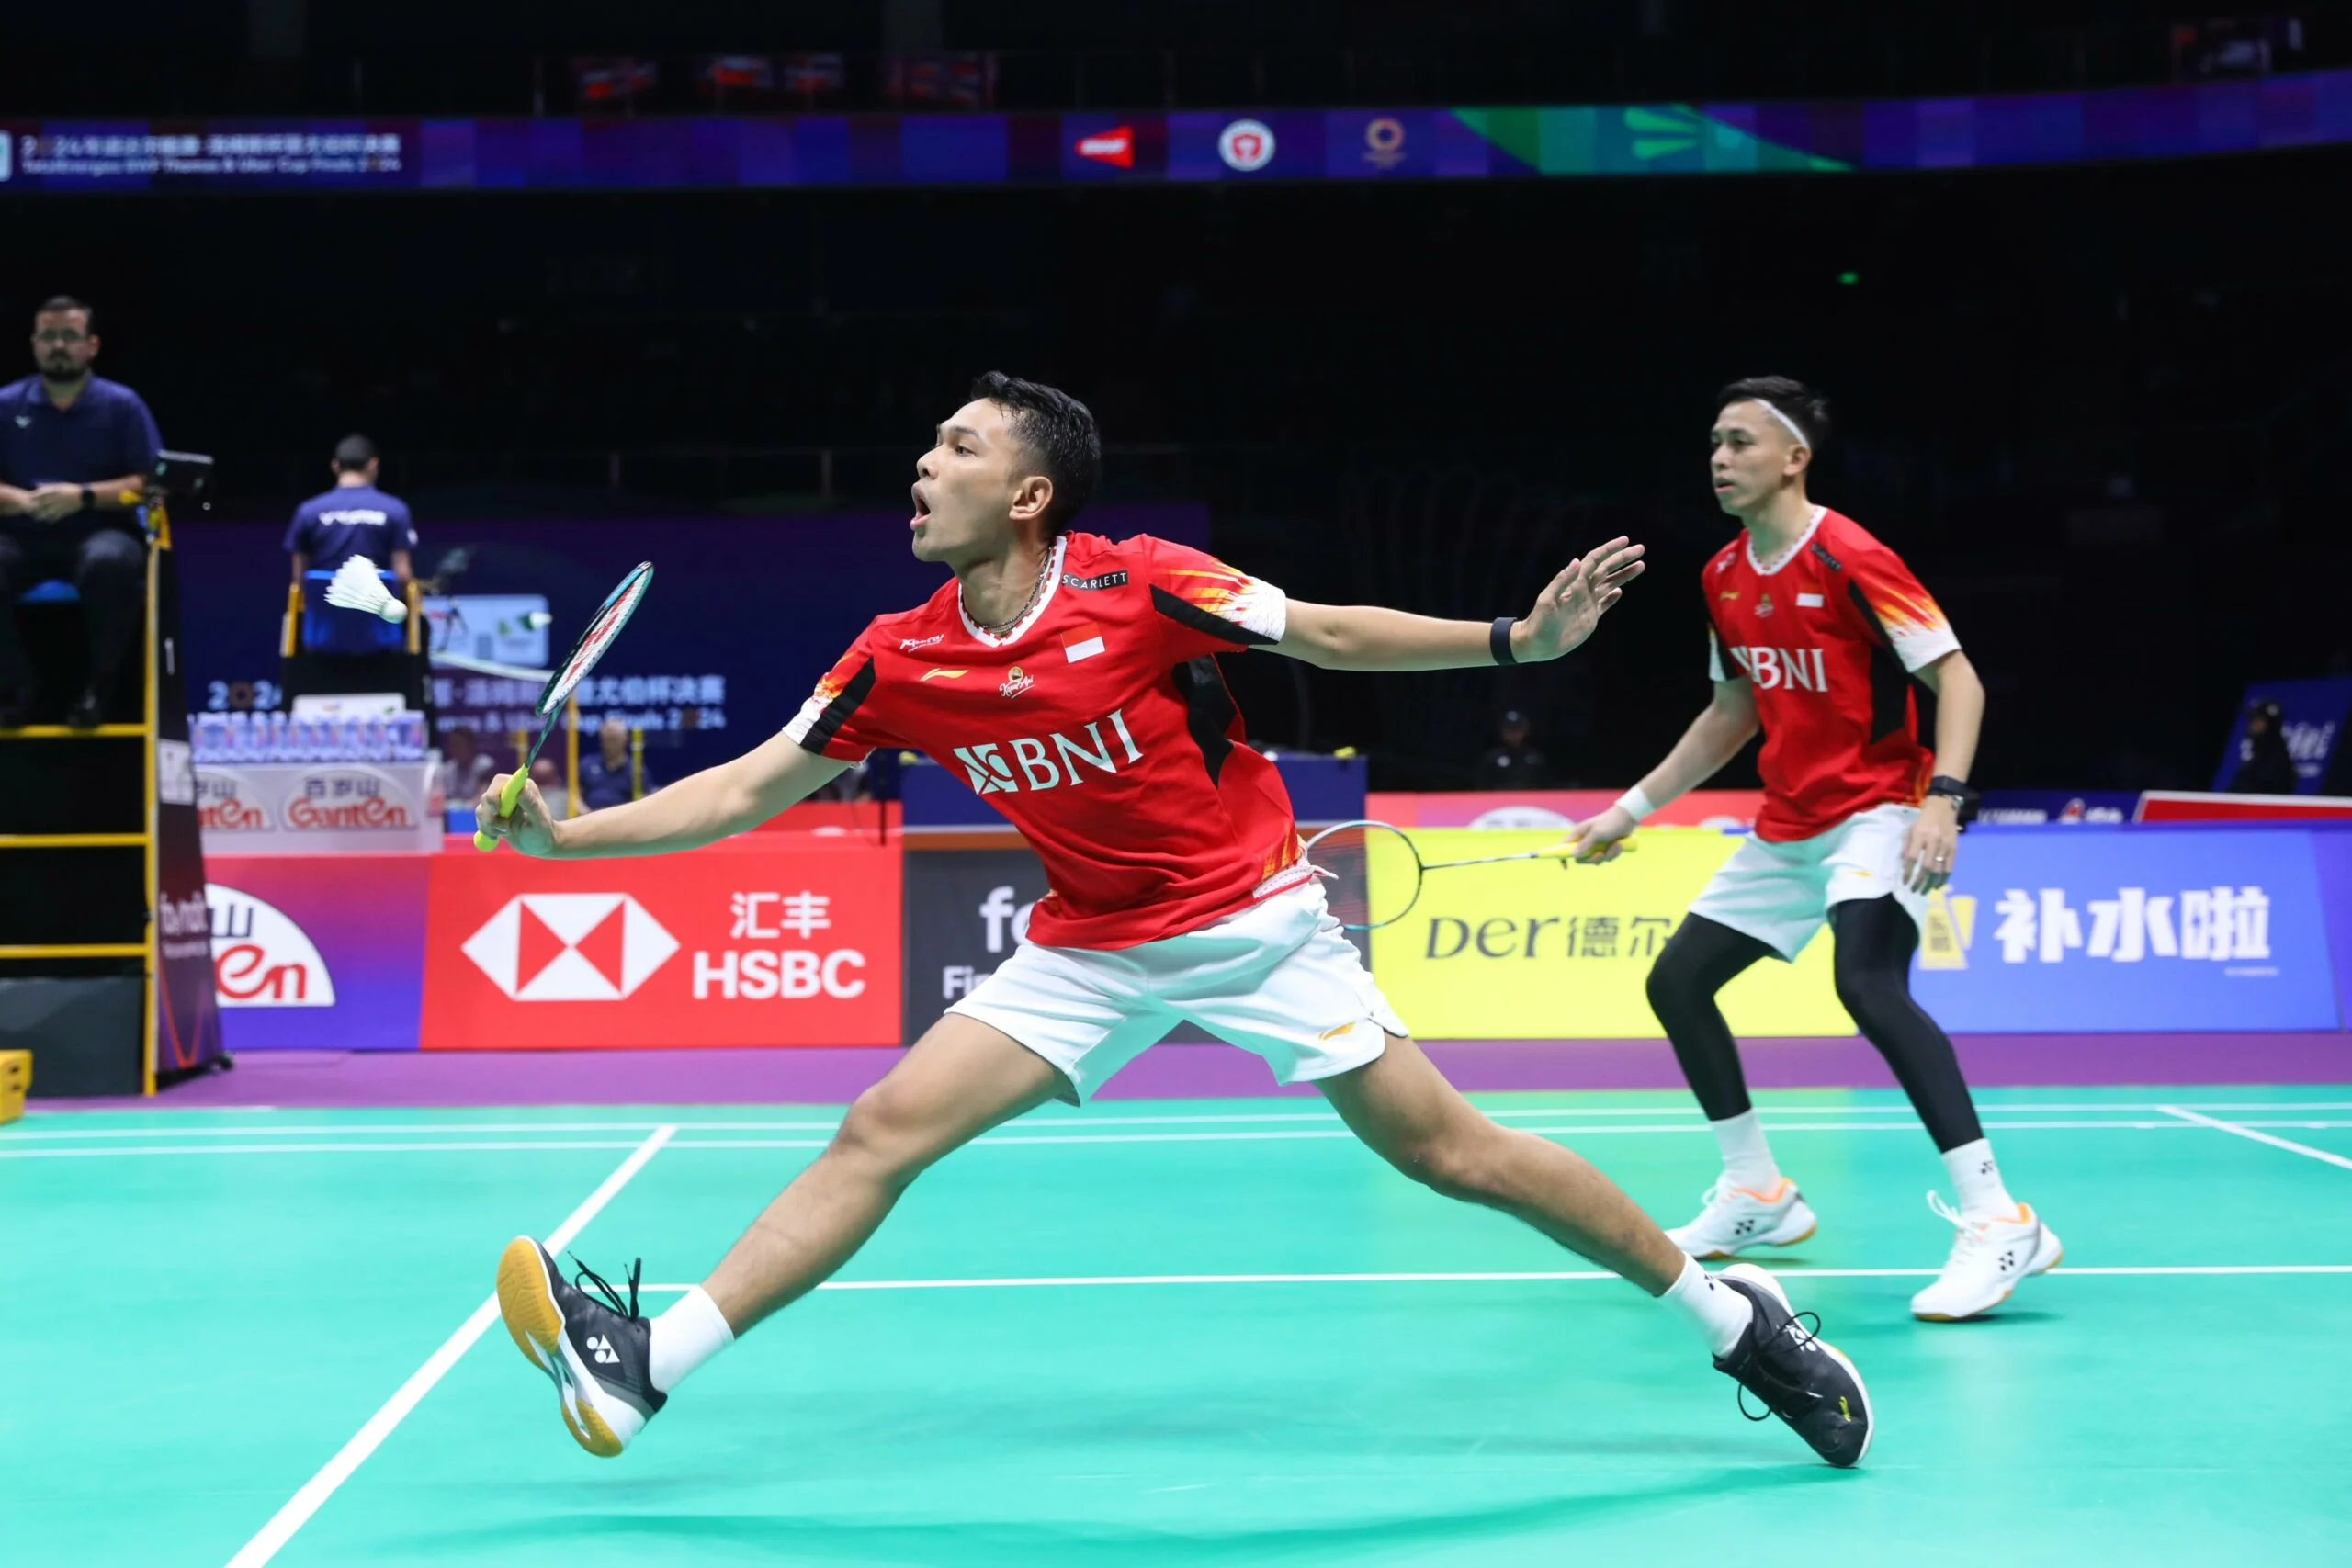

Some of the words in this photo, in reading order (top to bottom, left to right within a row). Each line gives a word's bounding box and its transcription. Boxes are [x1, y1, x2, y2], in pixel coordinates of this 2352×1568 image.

[1062, 572, 1127, 589] SCARLETT
[1749, 646, 1828, 693] BNI
[1008, 709, 1144, 791] BNI
[729, 890, 831, 939] 汇丰
[1425, 917, 1560, 959] Der
[1994, 886, 2271, 964] 补水啦
[693, 948, 867, 1000] HSBC
